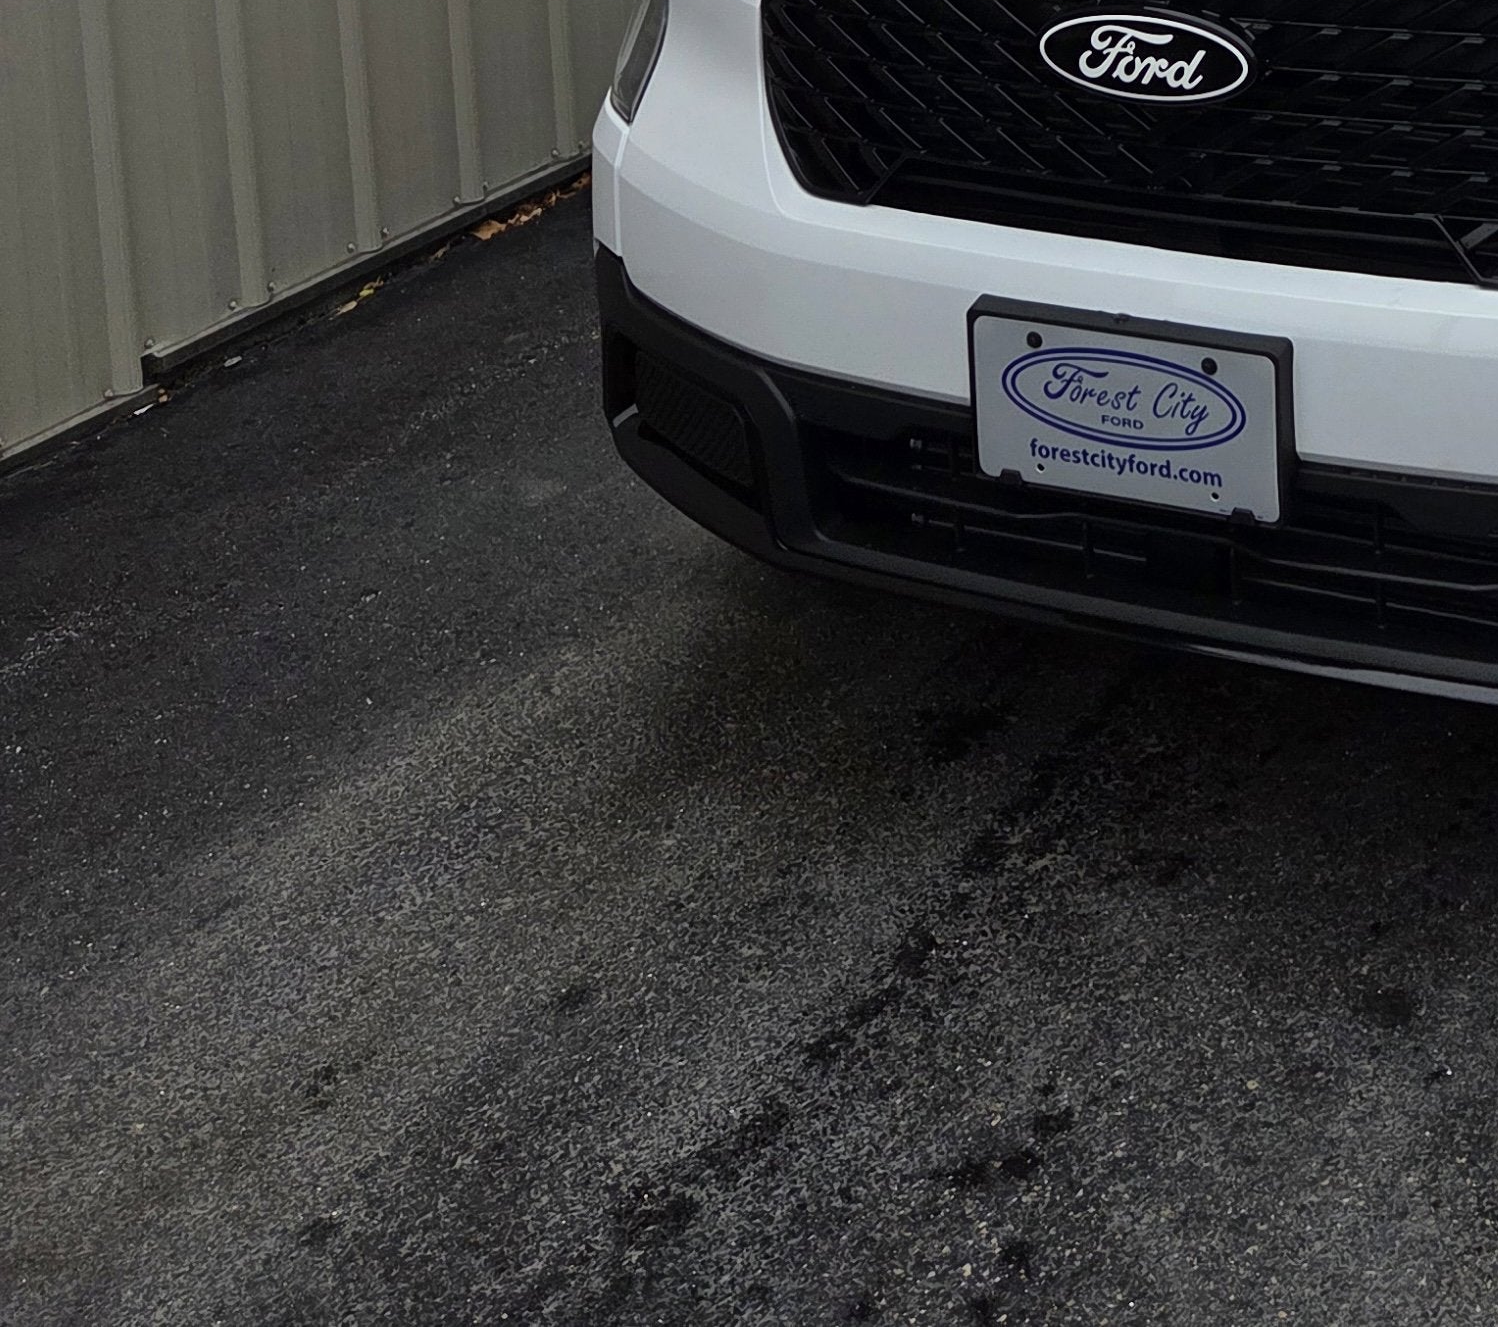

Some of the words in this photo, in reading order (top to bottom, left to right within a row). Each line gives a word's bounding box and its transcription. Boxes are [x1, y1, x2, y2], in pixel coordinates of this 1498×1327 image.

[1078, 24, 1207, 90] Ford
[1043, 362, 1142, 411] Forest
[1153, 381, 1209, 436] City
[1101, 414, 1144, 430] FORD
[1029, 437, 1223, 488] forestcityford.com
